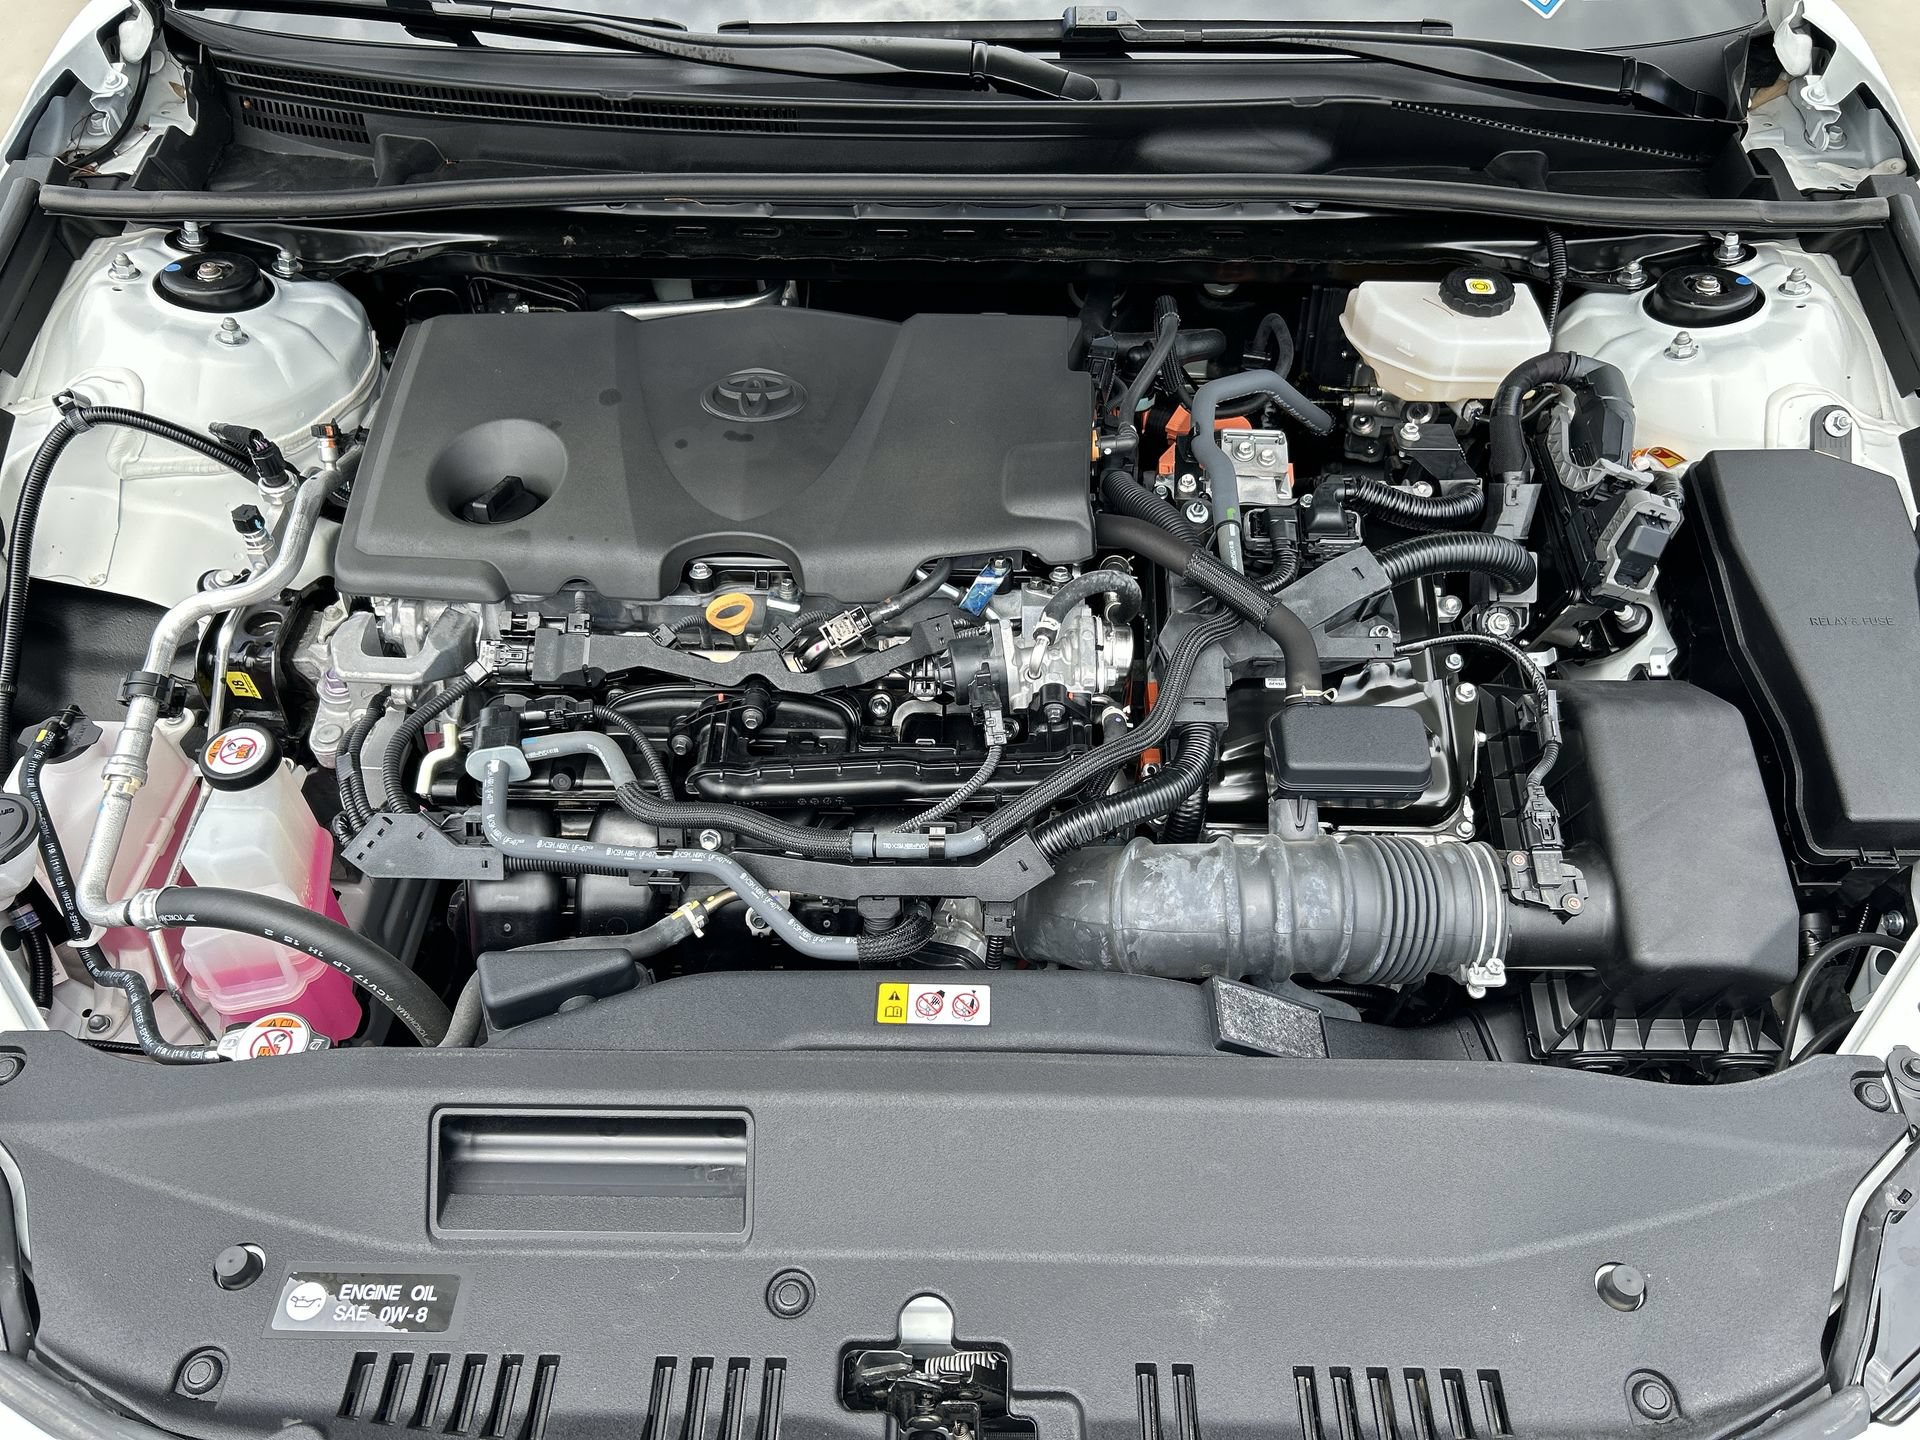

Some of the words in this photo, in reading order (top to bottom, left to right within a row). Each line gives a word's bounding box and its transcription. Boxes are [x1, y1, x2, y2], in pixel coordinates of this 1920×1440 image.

[1809, 617, 1847, 626] RELAY
[1851, 617, 1859, 626] &
[1862, 617, 1895, 626] FUSE
[264, 928, 274, 936] 2
[284, 935, 300, 946] 15
[308, 946, 324, 957] 1H
[332, 960, 352, 973] LP
[354, 974, 394, 1002] ACV17
[396, 1004, 428, 1038] YOKOHAMA
[338, 1284, 402, 1301] ENGINE
[410, 1285, 438, 1302] OIL
[333, 1305, 370, 1322] SAE
[379, 1305, 429, 1324] 0W-8
